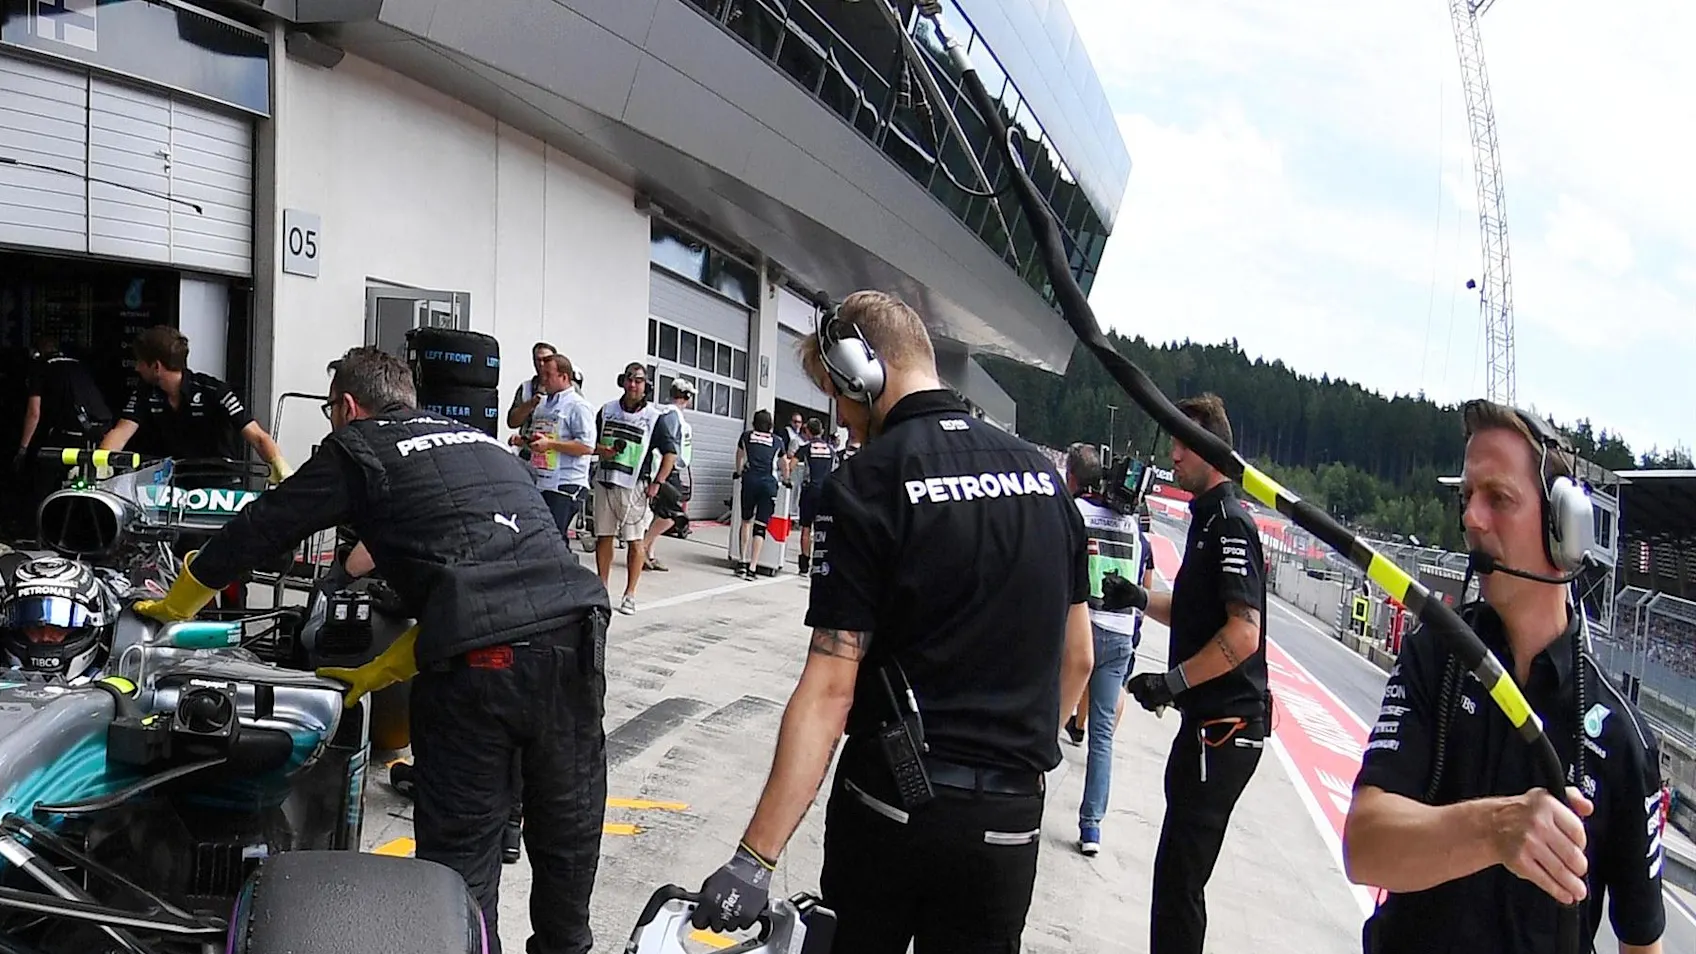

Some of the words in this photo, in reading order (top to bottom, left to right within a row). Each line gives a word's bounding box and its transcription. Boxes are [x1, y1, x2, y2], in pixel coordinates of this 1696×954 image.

[289, 227, 316, 259] 05
[445, 351, 473, 363] FRONT
[905, 472, 1055, 504] PETRONAS
[18, 586, 72, 598] PETRONAS
